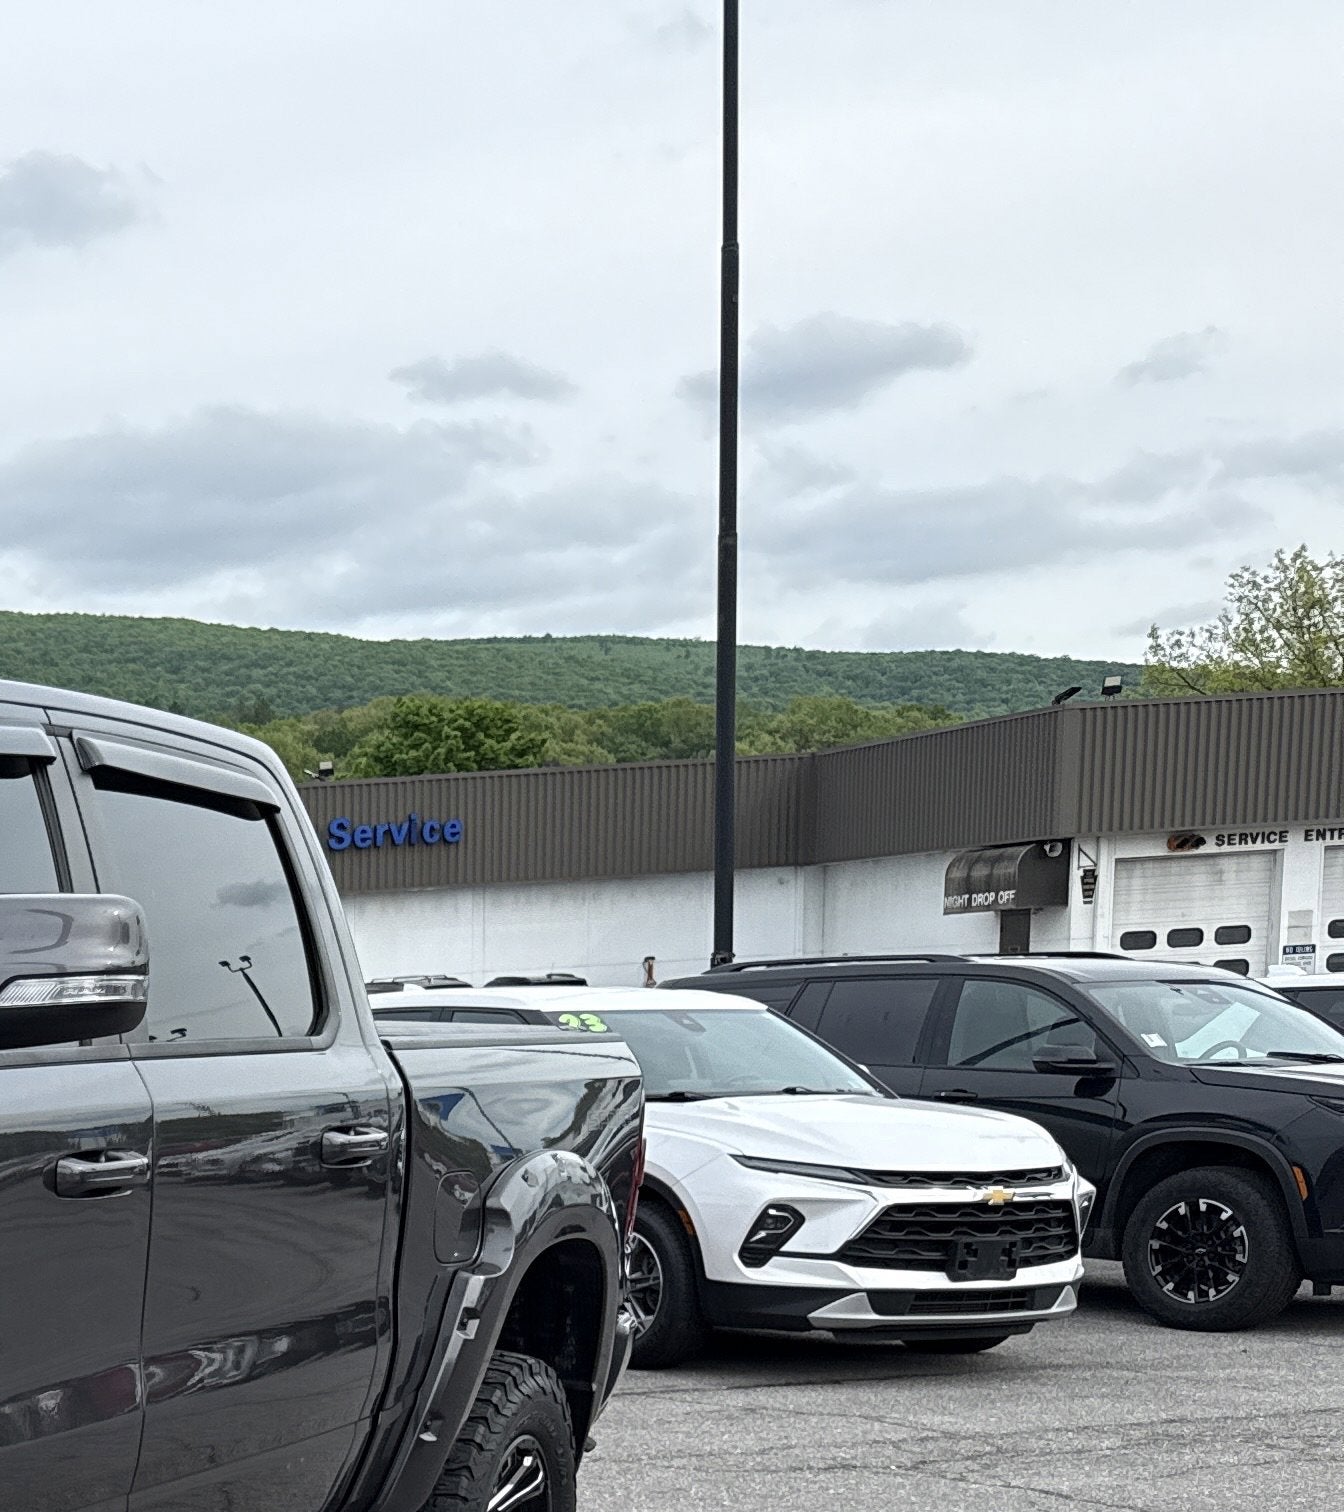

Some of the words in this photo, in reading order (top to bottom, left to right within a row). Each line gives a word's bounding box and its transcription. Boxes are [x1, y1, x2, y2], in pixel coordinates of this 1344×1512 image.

[328, 812, 462, 850] Service
[1214, 830, 1289, 846] SERVICE
[944, 894, 970, 907] NIGHT
[971, 892, 996, 906] DROP
[997, 890, 1016, 904] OFF
[558, 1013, 608, 1032] 23
